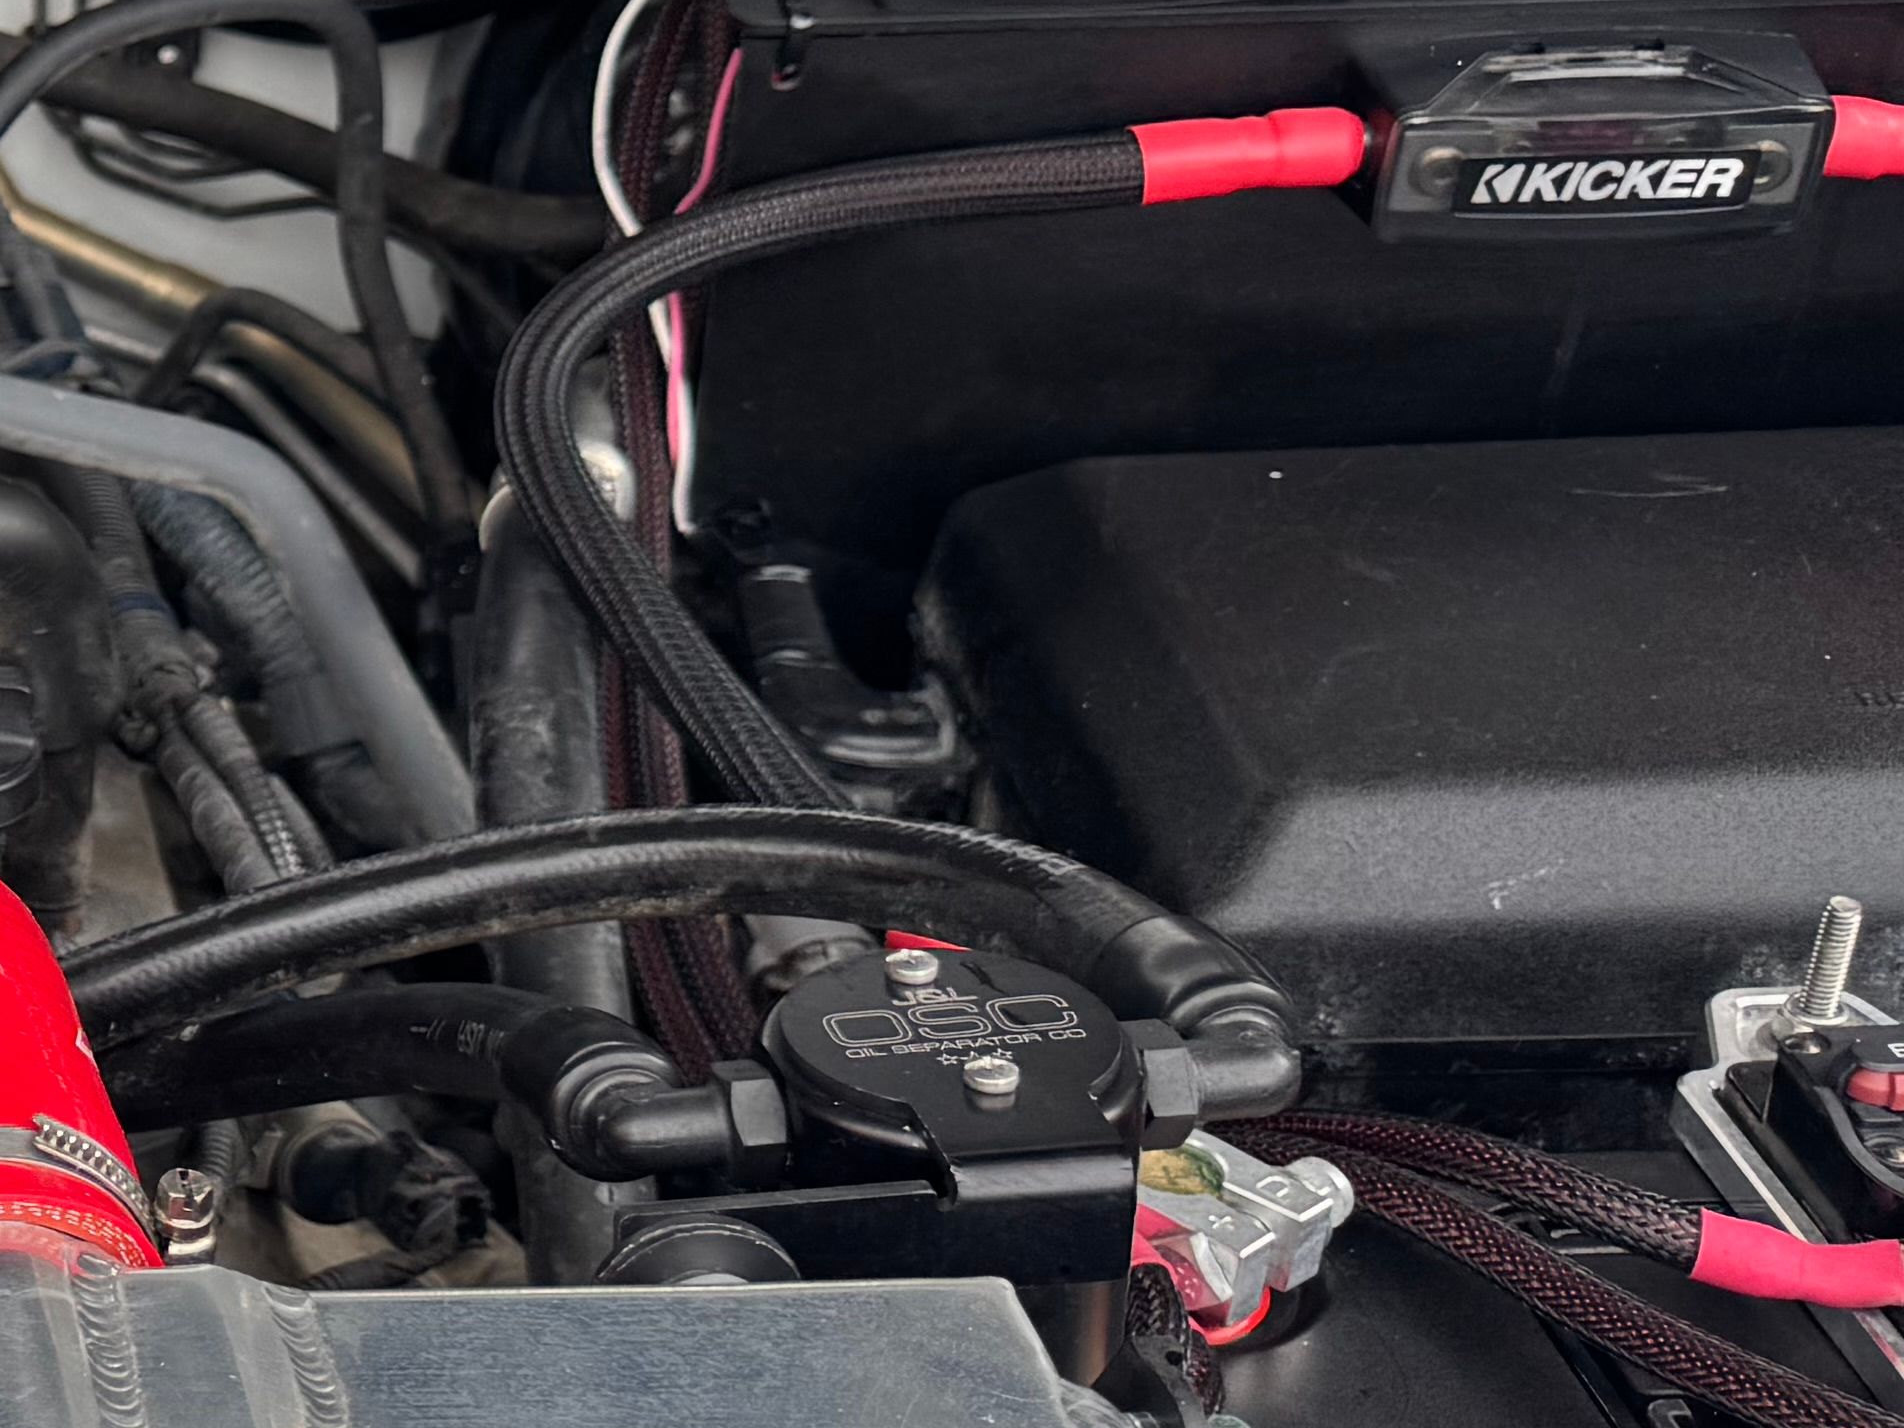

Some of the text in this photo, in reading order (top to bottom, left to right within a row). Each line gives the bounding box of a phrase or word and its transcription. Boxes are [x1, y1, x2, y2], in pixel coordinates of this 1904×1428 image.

[1518, 158, 1745, 202] KICKER
[891, 986, 979, 1006] J&L
[822, 993, 1079, 1048] OSC
[845, 1028, 1087, 1059] OIL SEPARATOR CO
